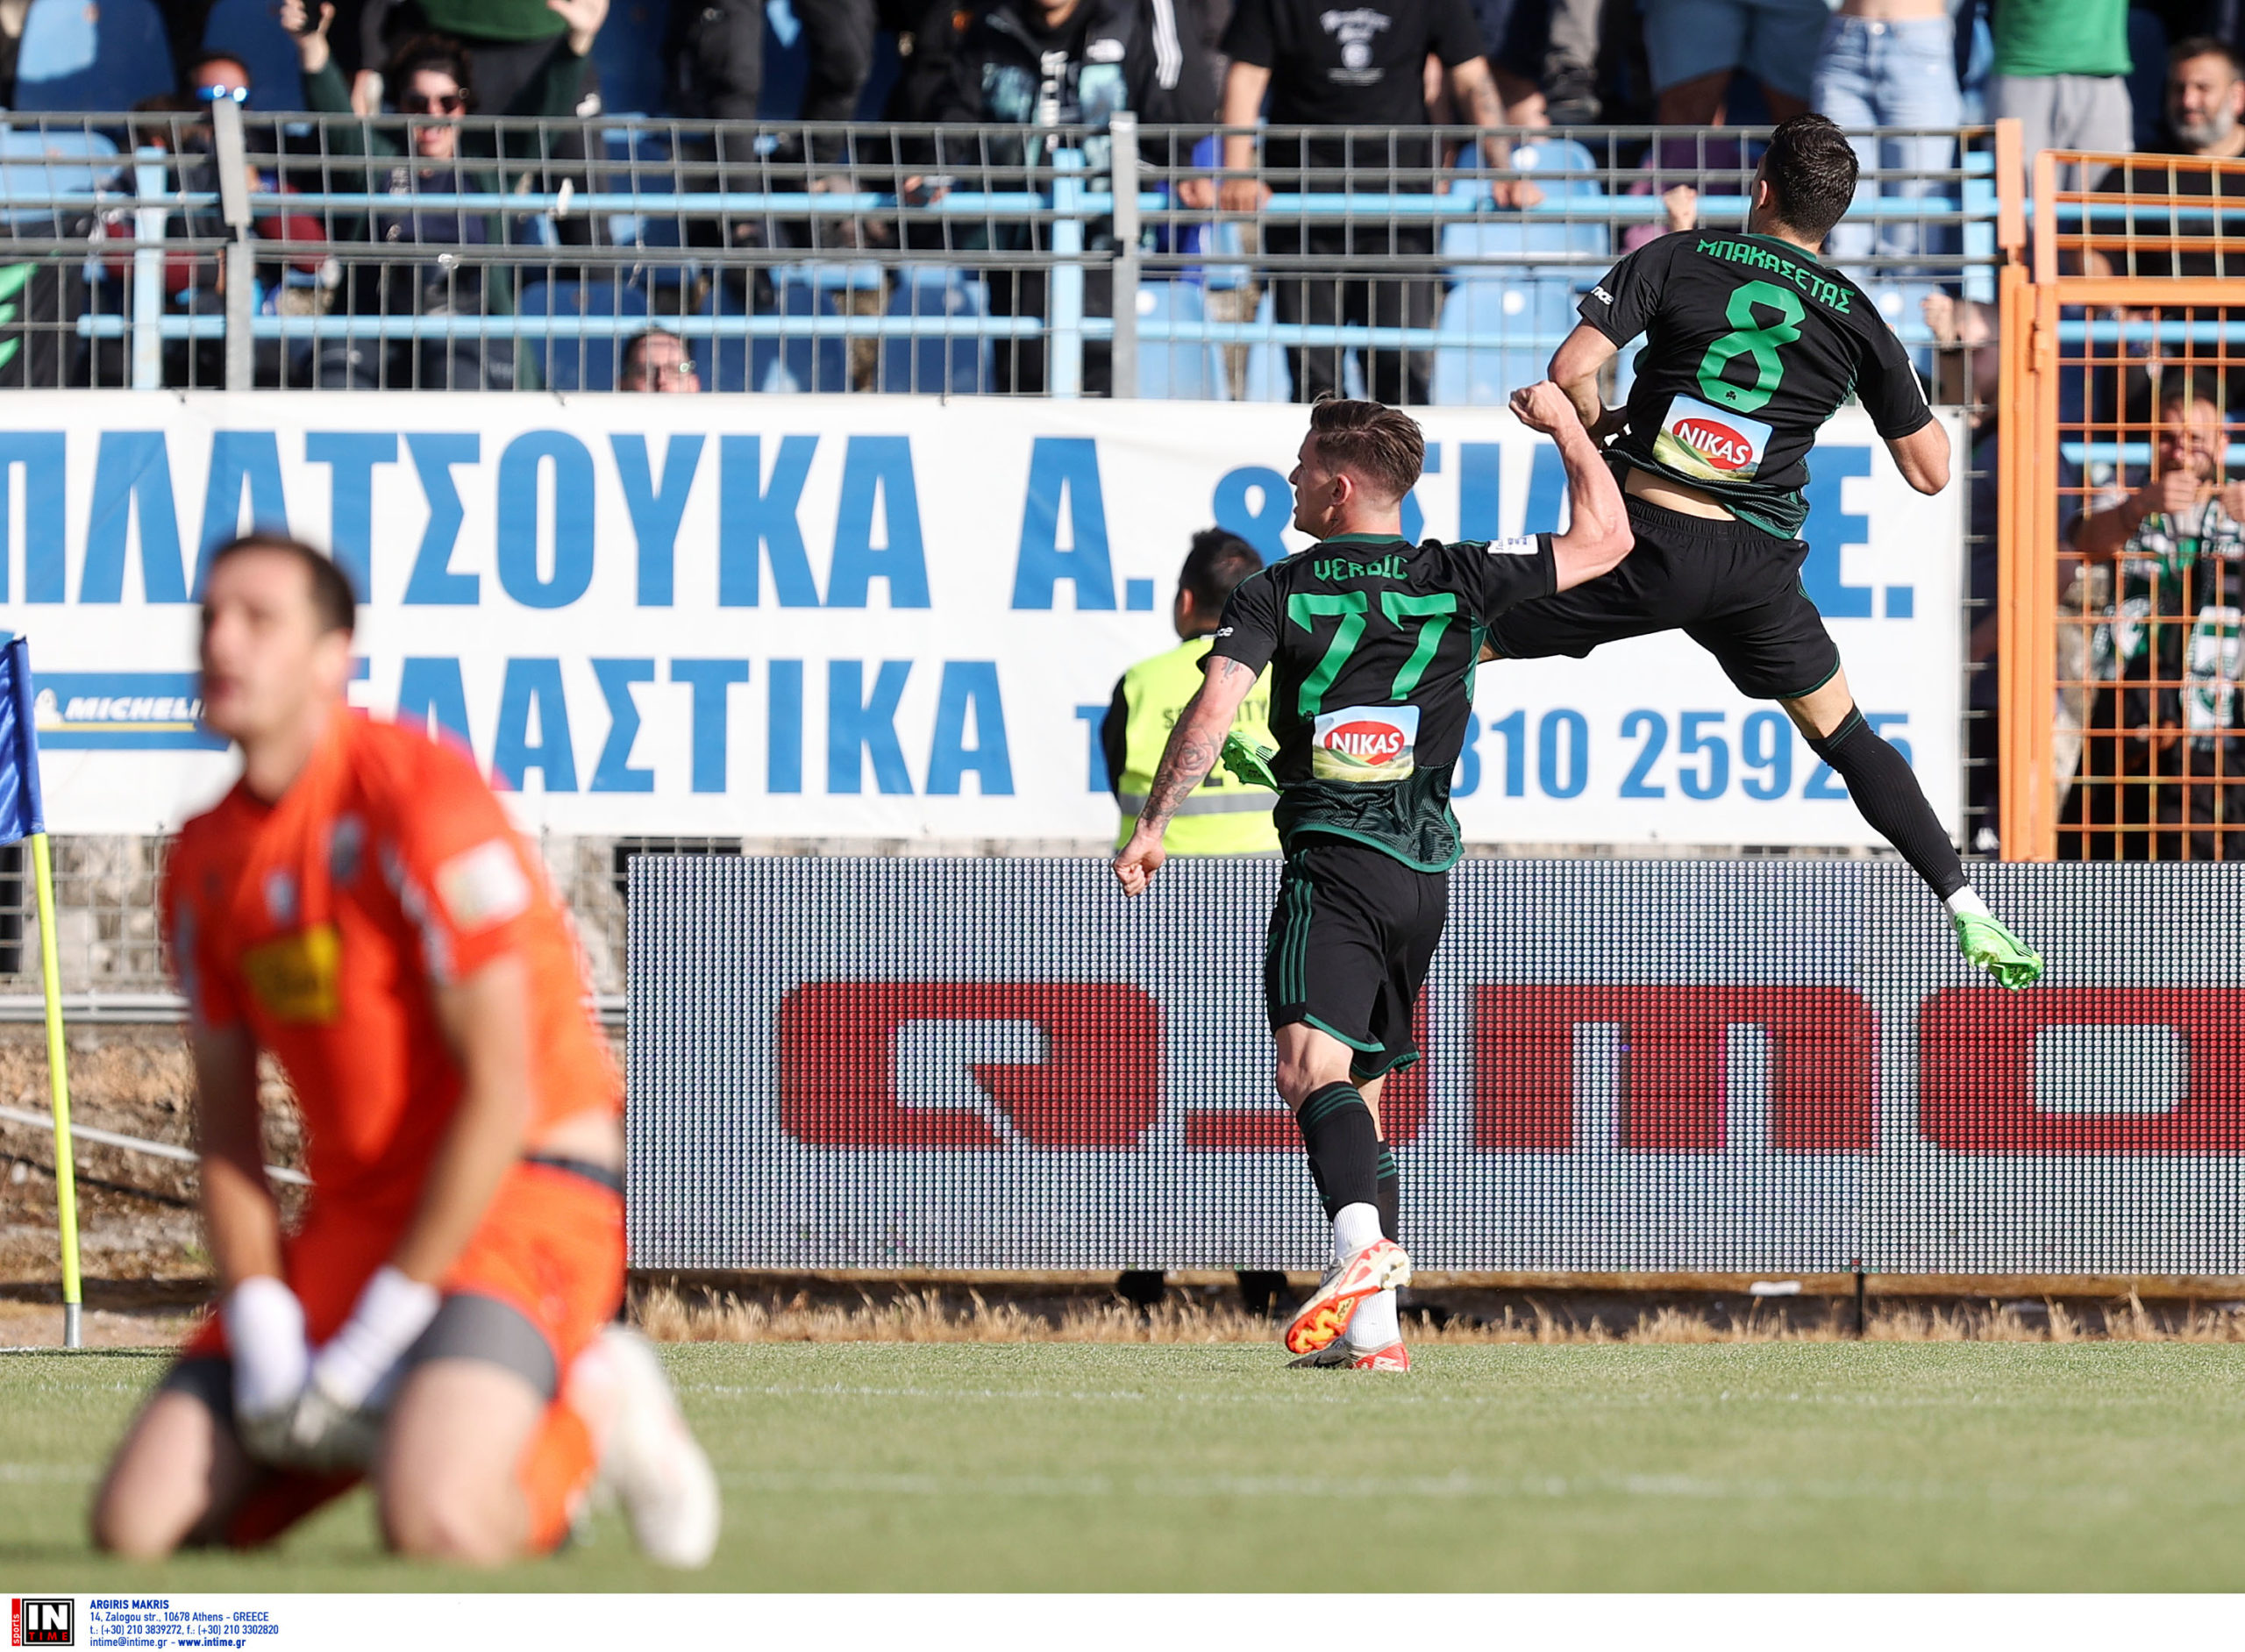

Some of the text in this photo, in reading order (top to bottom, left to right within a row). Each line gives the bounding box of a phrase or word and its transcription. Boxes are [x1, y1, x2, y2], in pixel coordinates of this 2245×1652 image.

[1696, 238, 1855, 315] ΜΠΑΚΑΣΕΤΑΣ
[1695, 279, 1807, 414] 8
[1675, 422, 1751, 465] NIKAS
[1288, 590, 1457, 721] 77
[65, 695, 207, 721] MICHELI
[348, 656, 1016, 795] ΛΑΣΤΙΚΑ
[1330, 731, 1400, 755] NIKAS
